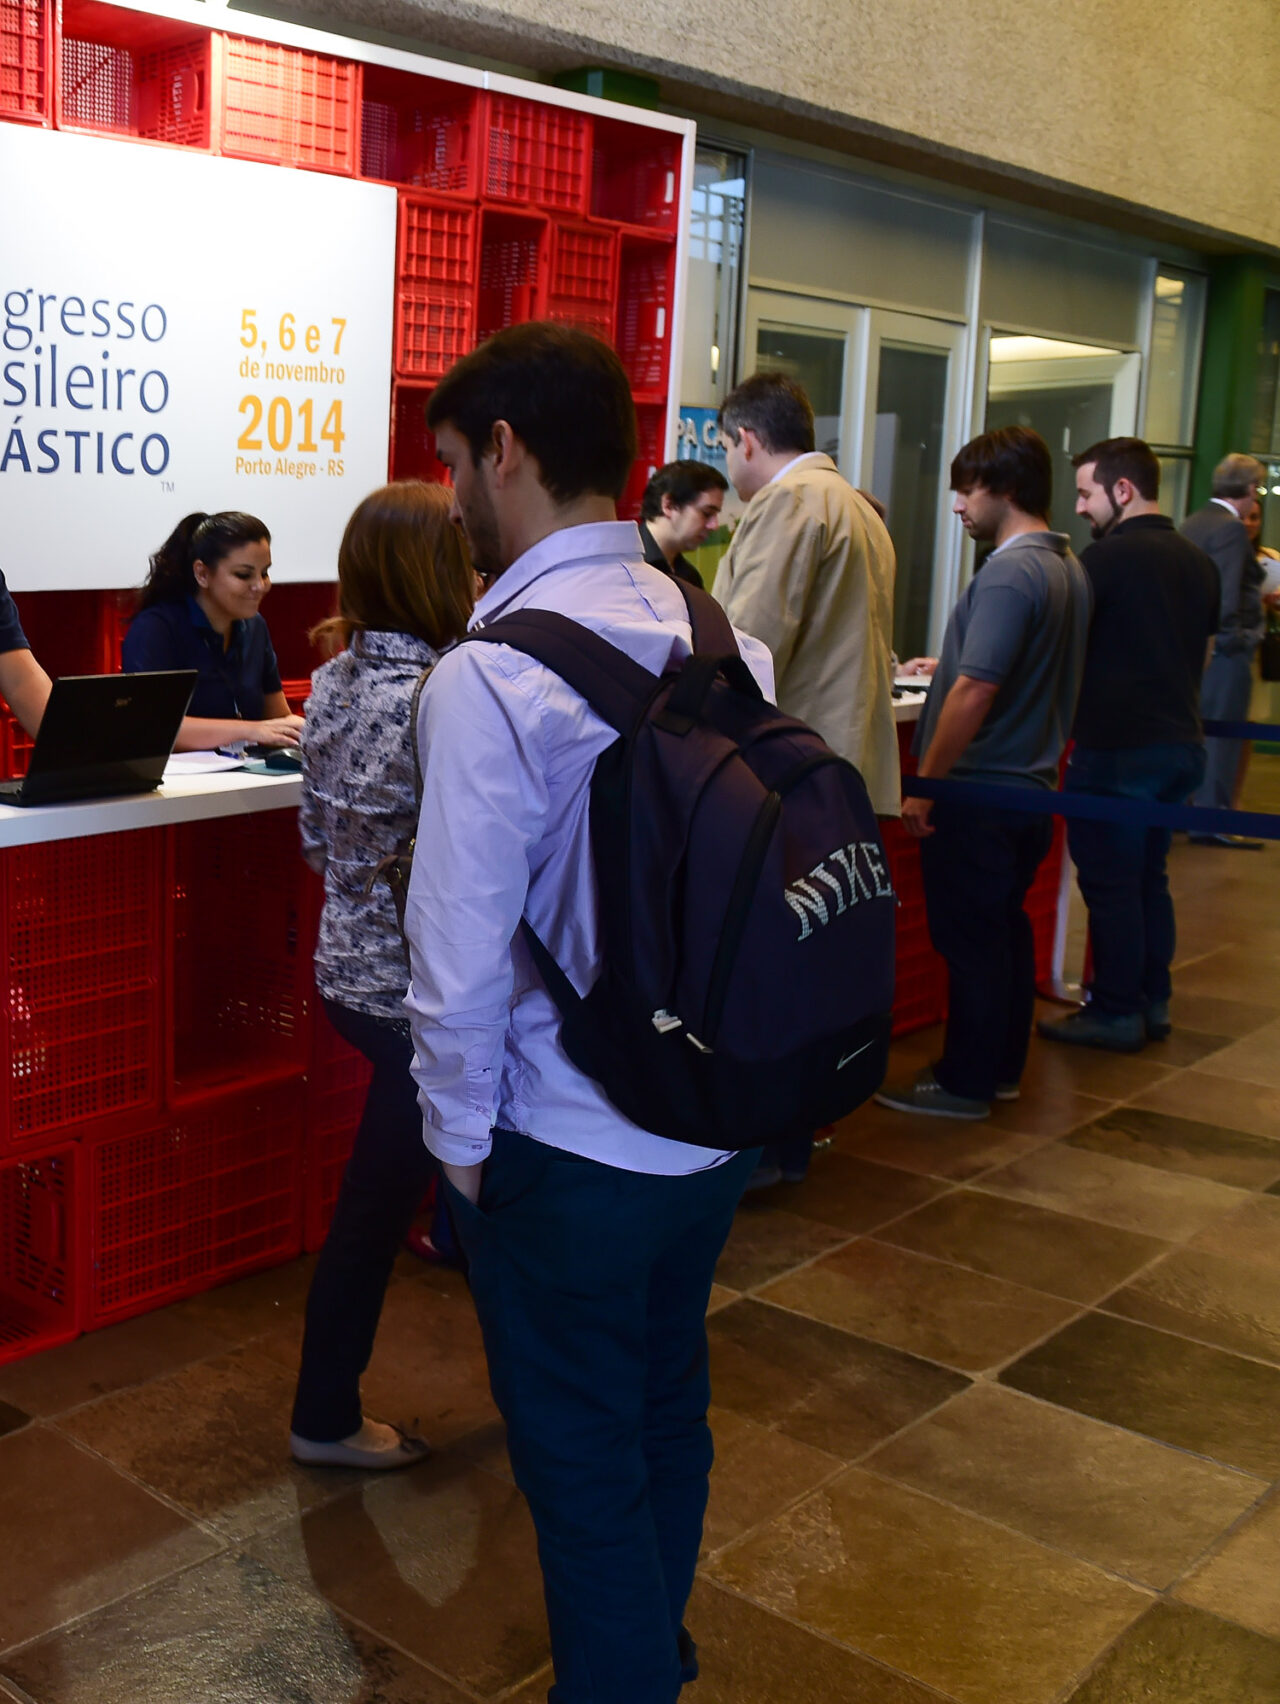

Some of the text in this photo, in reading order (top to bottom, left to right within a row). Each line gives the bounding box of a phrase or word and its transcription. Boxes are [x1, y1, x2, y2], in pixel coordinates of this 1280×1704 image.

[239, 309, 347, 357] 5, 6 e 7
[239, 355, 345, 384] de novembro
[237, 394, 345, 453] 2014
[235, 456, 271, 475] Porto
[275, 458, 316, 480] Alegre
[328, 459, 345, 477] RS
[784, 841, 893, 942] NIKE
